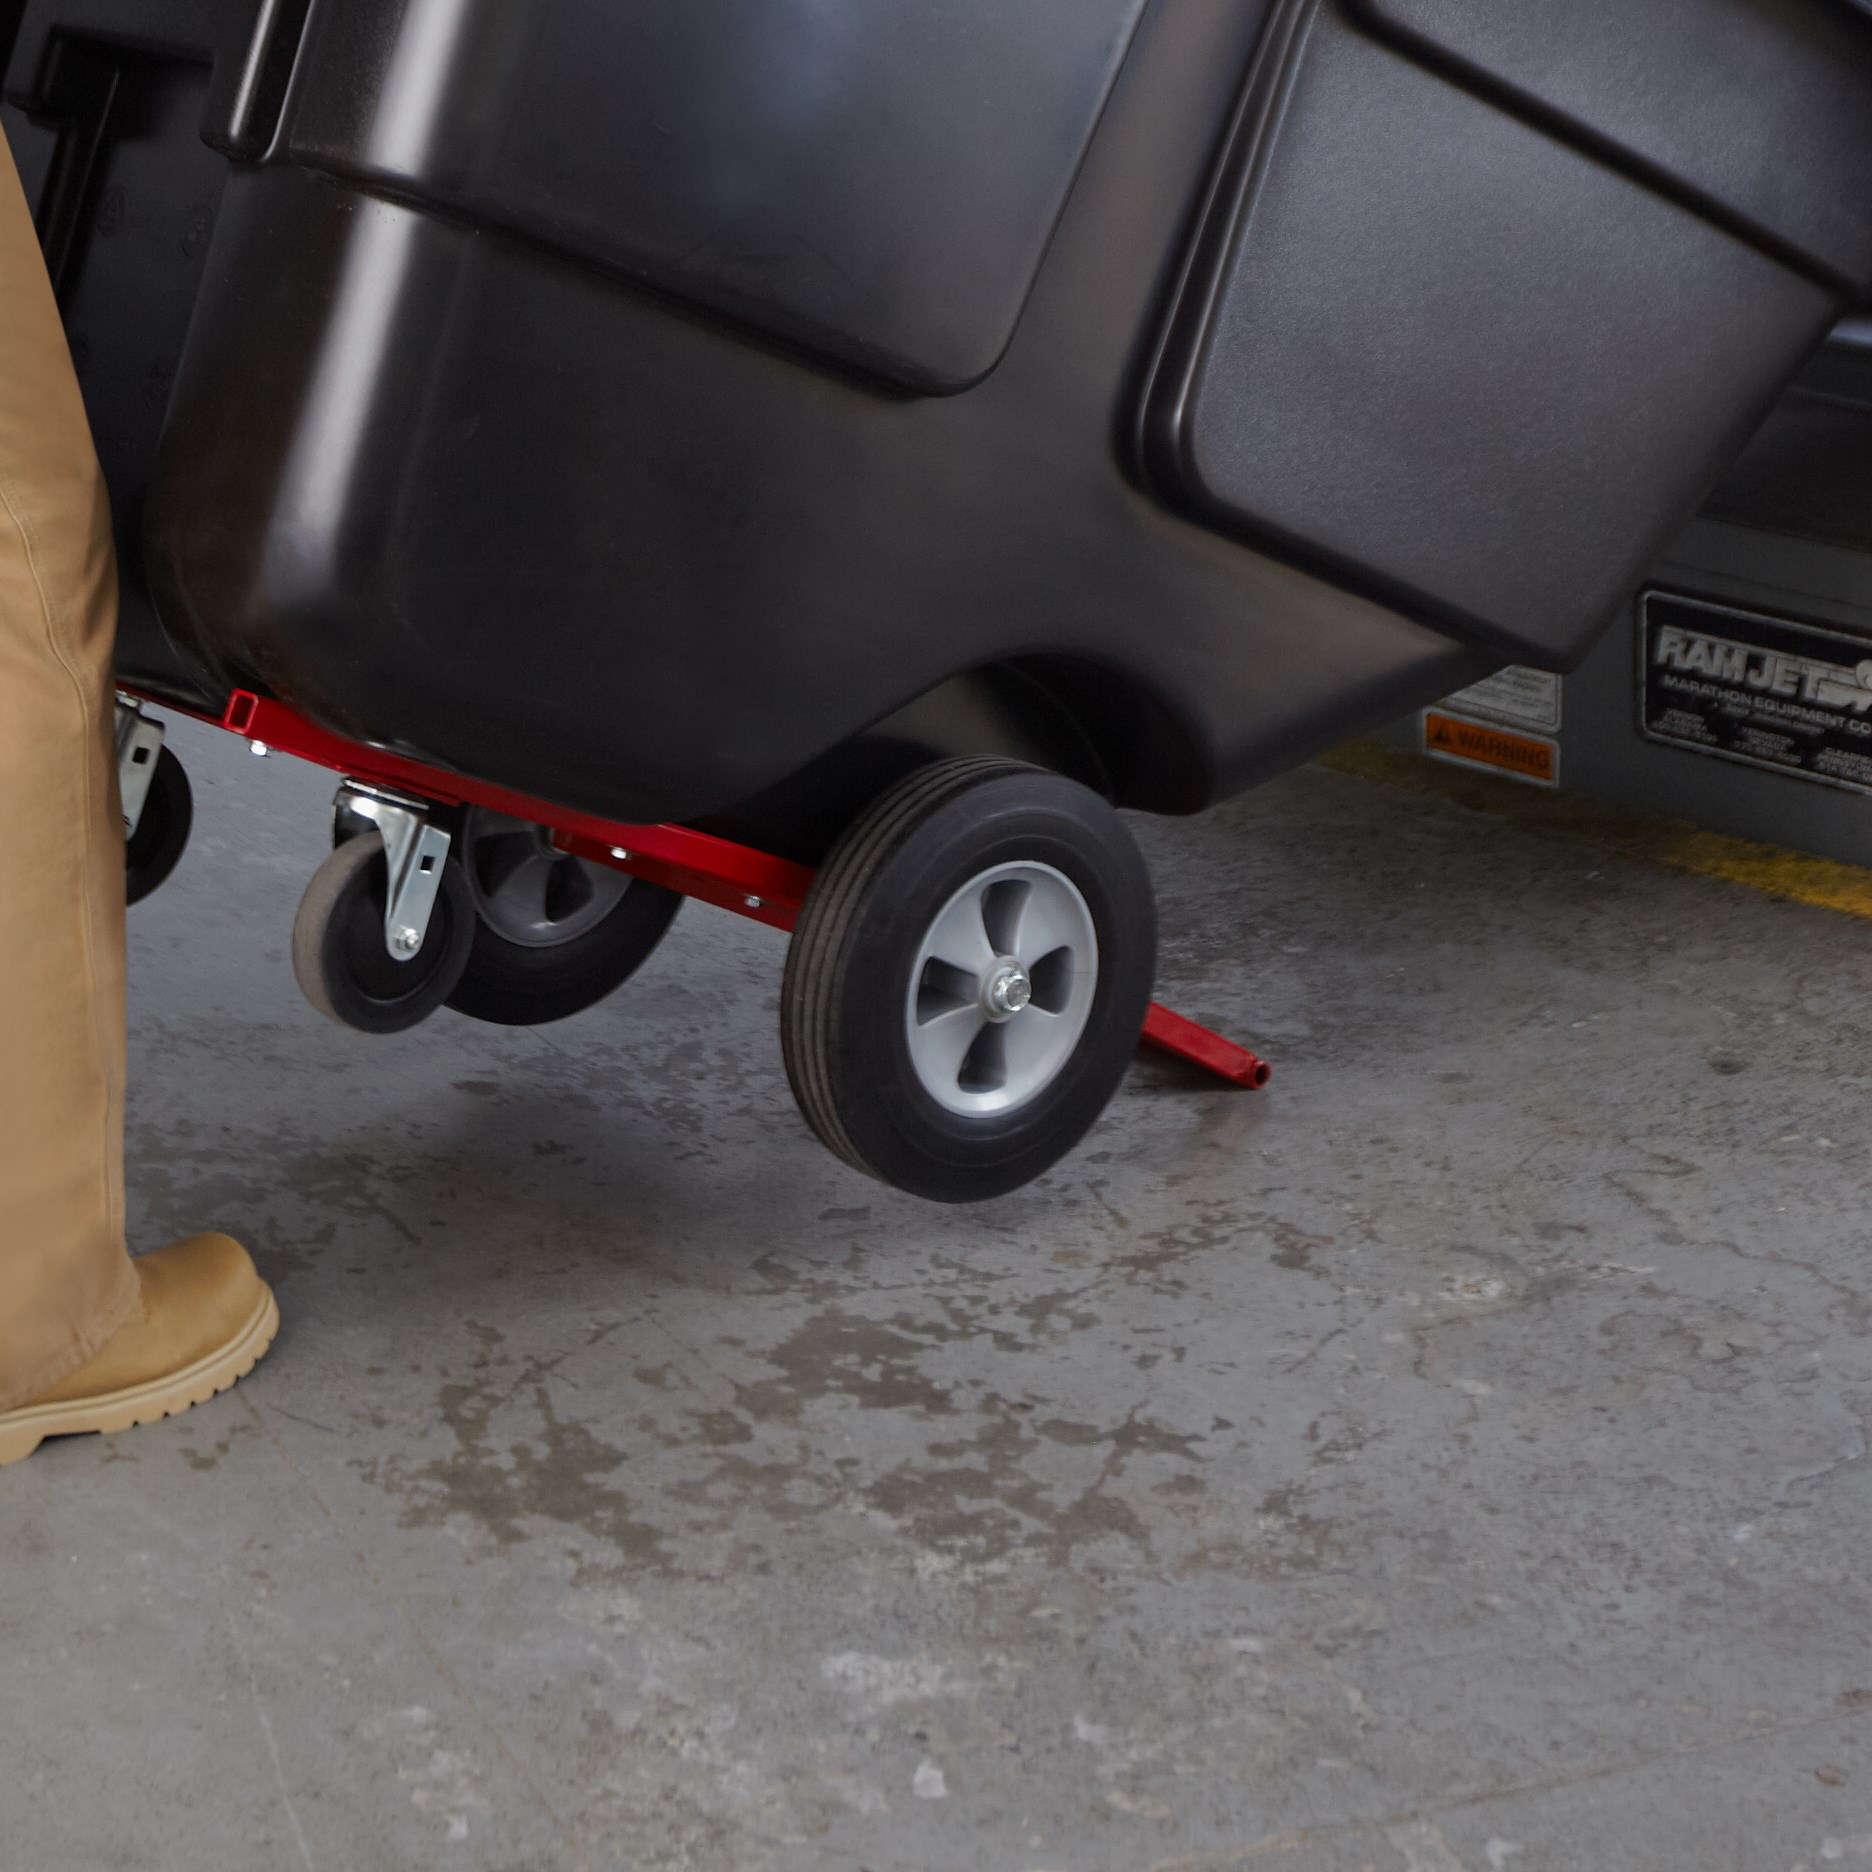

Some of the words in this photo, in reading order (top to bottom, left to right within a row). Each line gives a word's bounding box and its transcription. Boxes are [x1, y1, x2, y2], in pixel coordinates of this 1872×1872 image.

[1661, 673, 1754, 706] MARATHON
[1754, 697, 1848, 729] EQUIPMENT
[1458, 729, 1551, 769] WARNING
